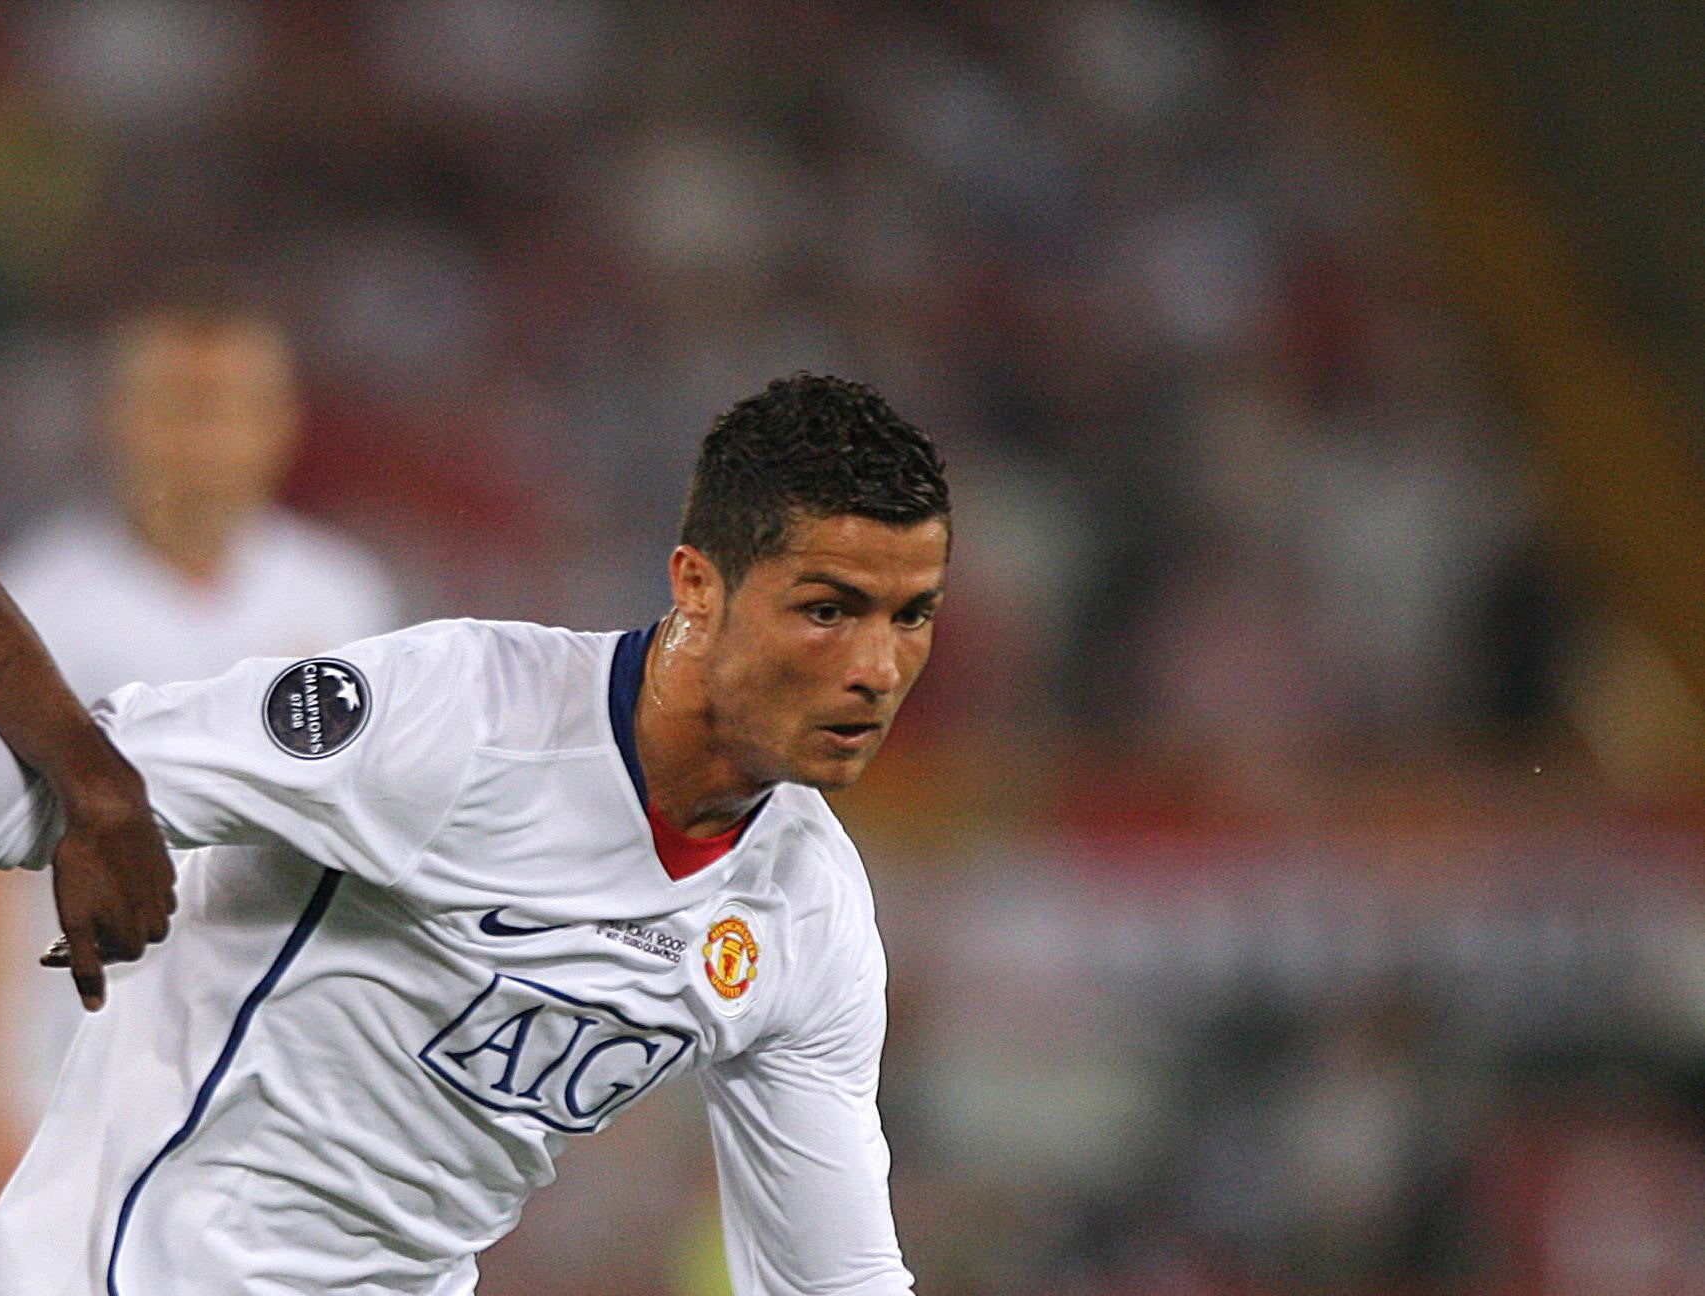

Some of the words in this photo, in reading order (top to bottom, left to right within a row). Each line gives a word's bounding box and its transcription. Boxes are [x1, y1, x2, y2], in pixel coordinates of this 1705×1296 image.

[303, 663, 324, 754] CHAMPIONS
[657, 933, 688, 953] 2009
[445, 1003, 661, 1119] AIG
